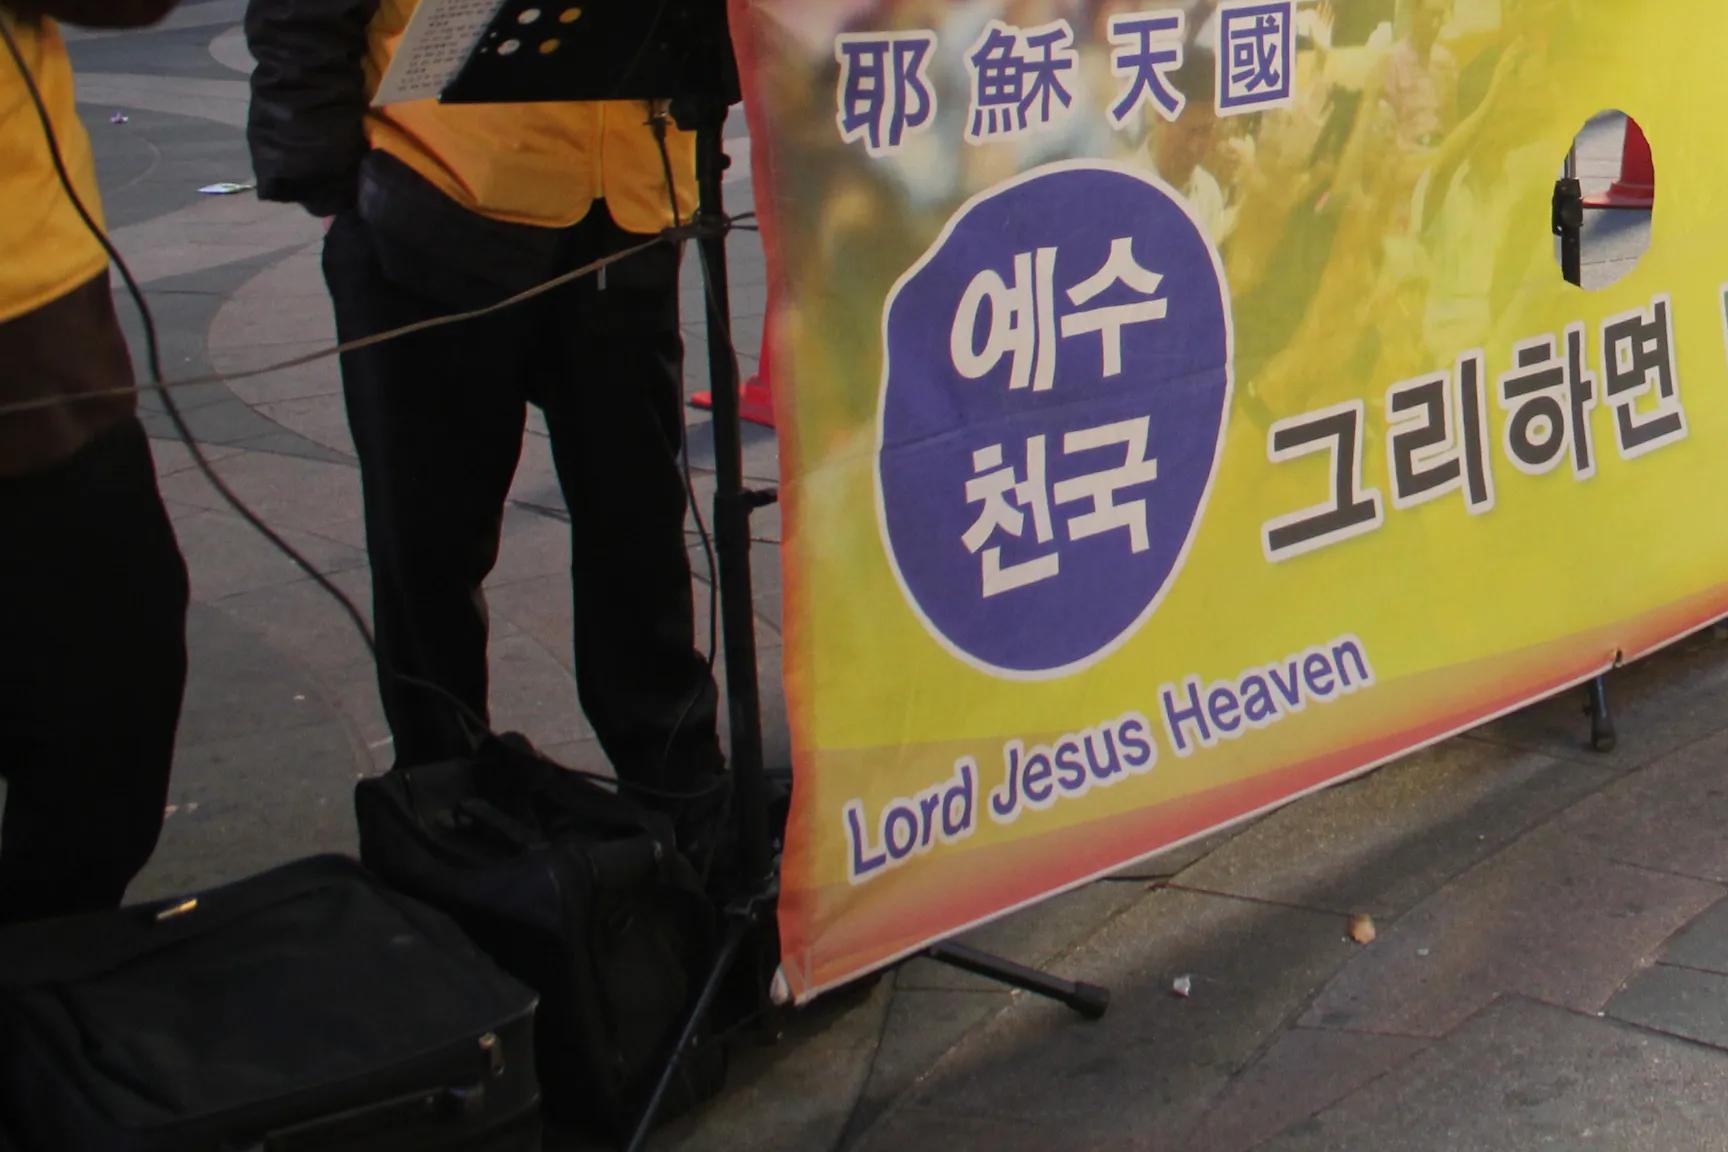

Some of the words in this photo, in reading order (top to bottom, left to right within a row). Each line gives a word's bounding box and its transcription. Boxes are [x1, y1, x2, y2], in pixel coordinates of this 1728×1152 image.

[840, 0, 1293, 148] 耶穌天國
[950, 236, 1168, 392] 예수
[961, 415, 1158, 598] 천국
[1268, 299, 1682, 551] 그리하면
[846, 765, 973, 876] Lord
[992, 717, 1151, 816] Jesus
[1161, 639, 1369, 748] Heaven
